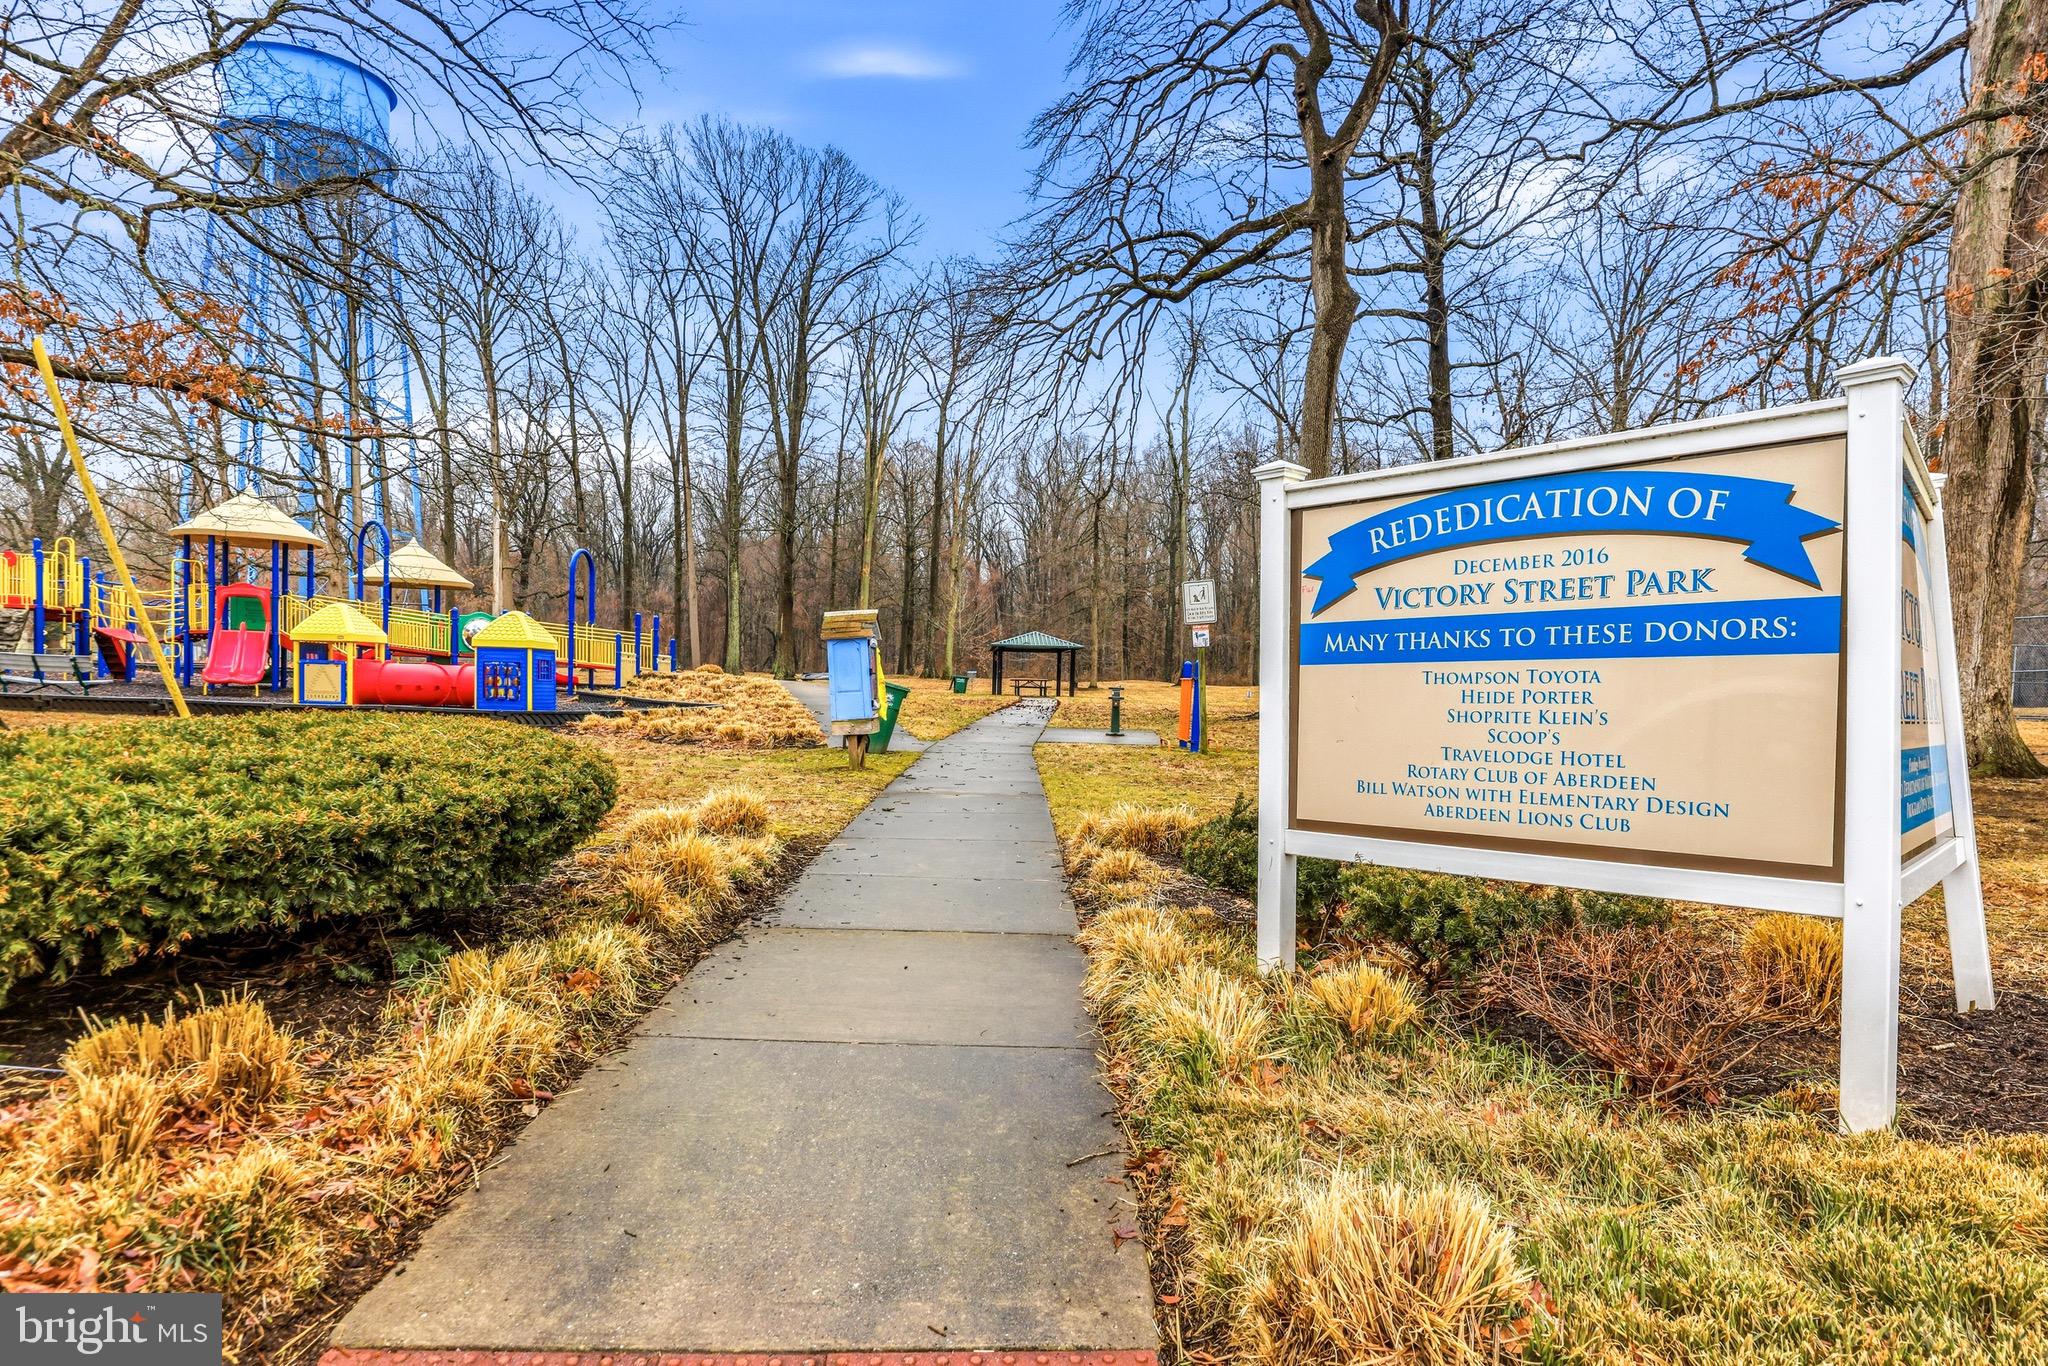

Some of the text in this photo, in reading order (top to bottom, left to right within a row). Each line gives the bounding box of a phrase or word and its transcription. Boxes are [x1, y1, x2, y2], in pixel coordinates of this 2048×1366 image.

[1369, 486, 1729, 554] REDEDICATION OF
[1454, 547, 1609, 575] DECEMBER 2016
[1375, 567, 1717, 611] VICTORY STREET PARK
[1324, 616, 1798, 652] MANY THANKS TO THESE DONORS:
[1422, 669, 1601, 685] THOMPSON TOYOTA
[1461, 689, 1594, 705] HEIDE PORTER
[1447, 709, 1609, 725] SHOPRITE KLEIN'S
[1487, 729, 1560, 745] SCOOP'S
[1440, 746, 1626, 769] TRAVELODGE HOTEL
[1407, 764, 1657, 791] ROTARY CLUB OF ABERDEEN
[1356, 780, 1730, 818] BILL WATSON WITH ELEMENTARY DESIGN
[1424, 803, 1631, 832] ABERDEEN LIONS CLUB
